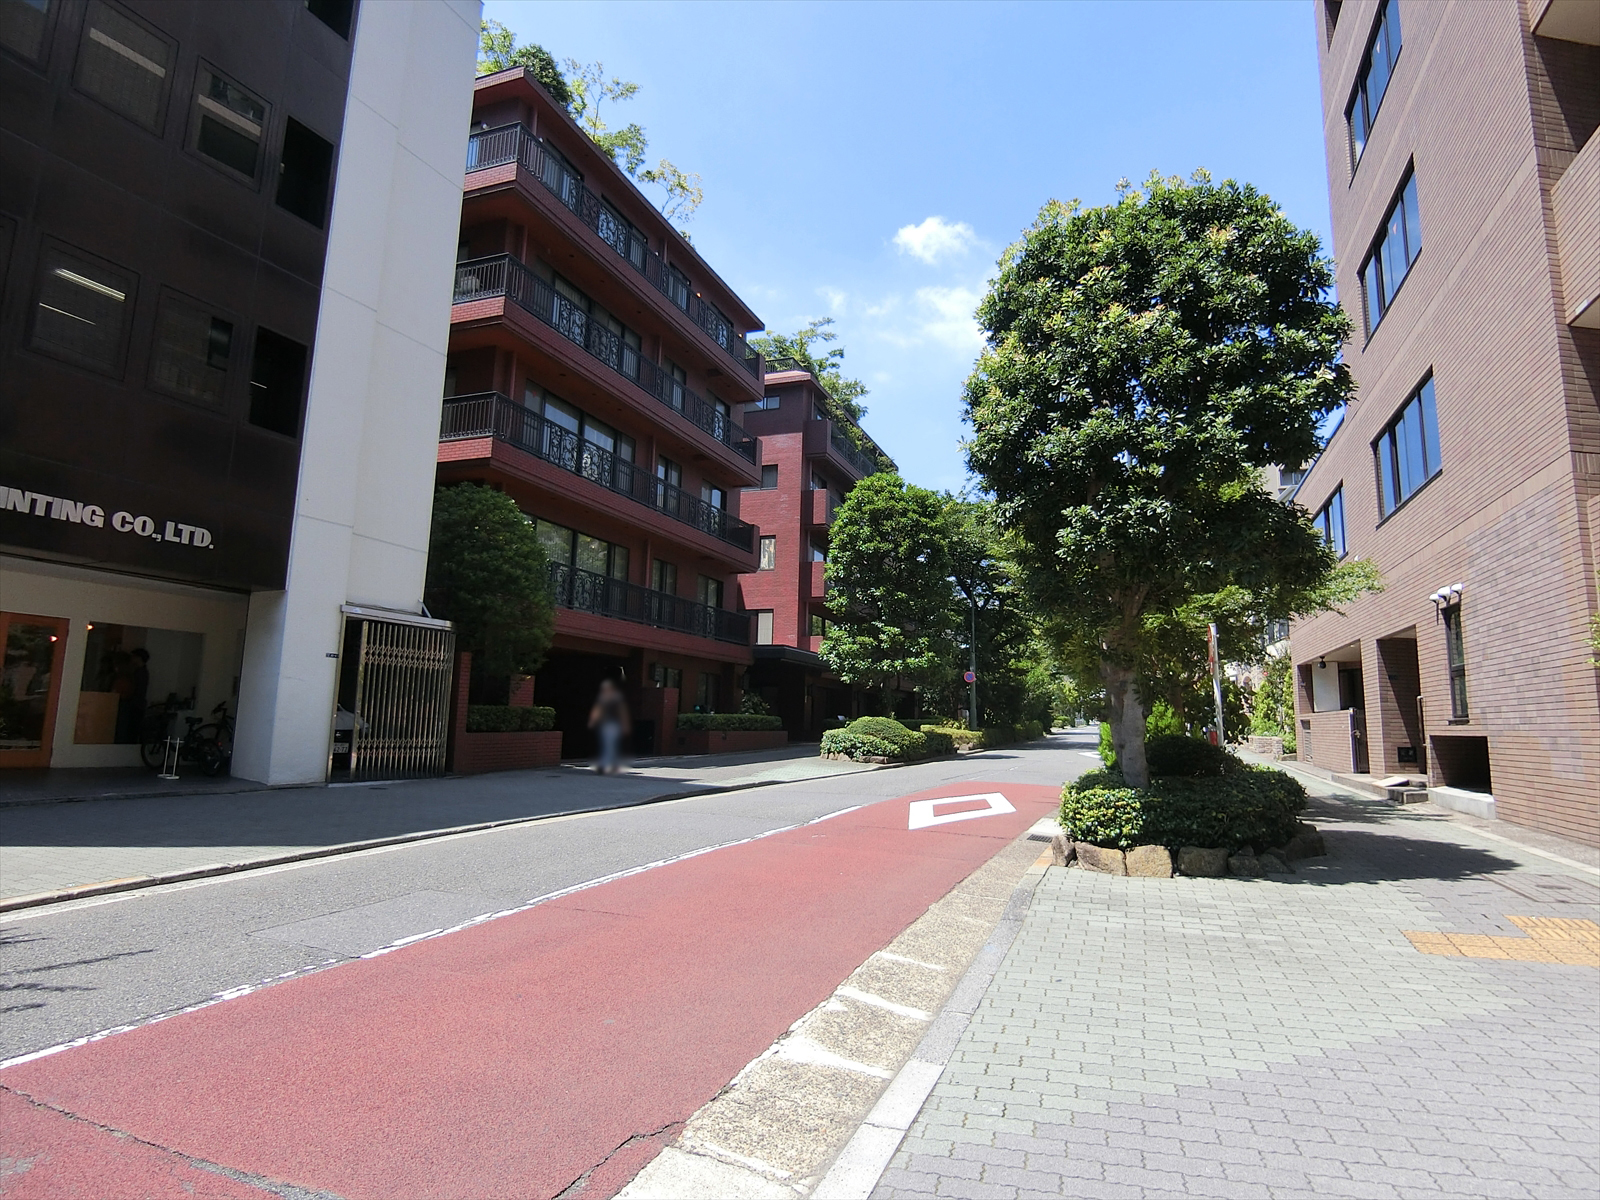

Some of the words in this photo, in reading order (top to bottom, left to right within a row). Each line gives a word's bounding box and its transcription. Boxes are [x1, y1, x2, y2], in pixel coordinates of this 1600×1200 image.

[0, 486, 105, 528] INTING
[112, 511, 162, 542] CO.,
[164, 521, 214, 549] LTD.
